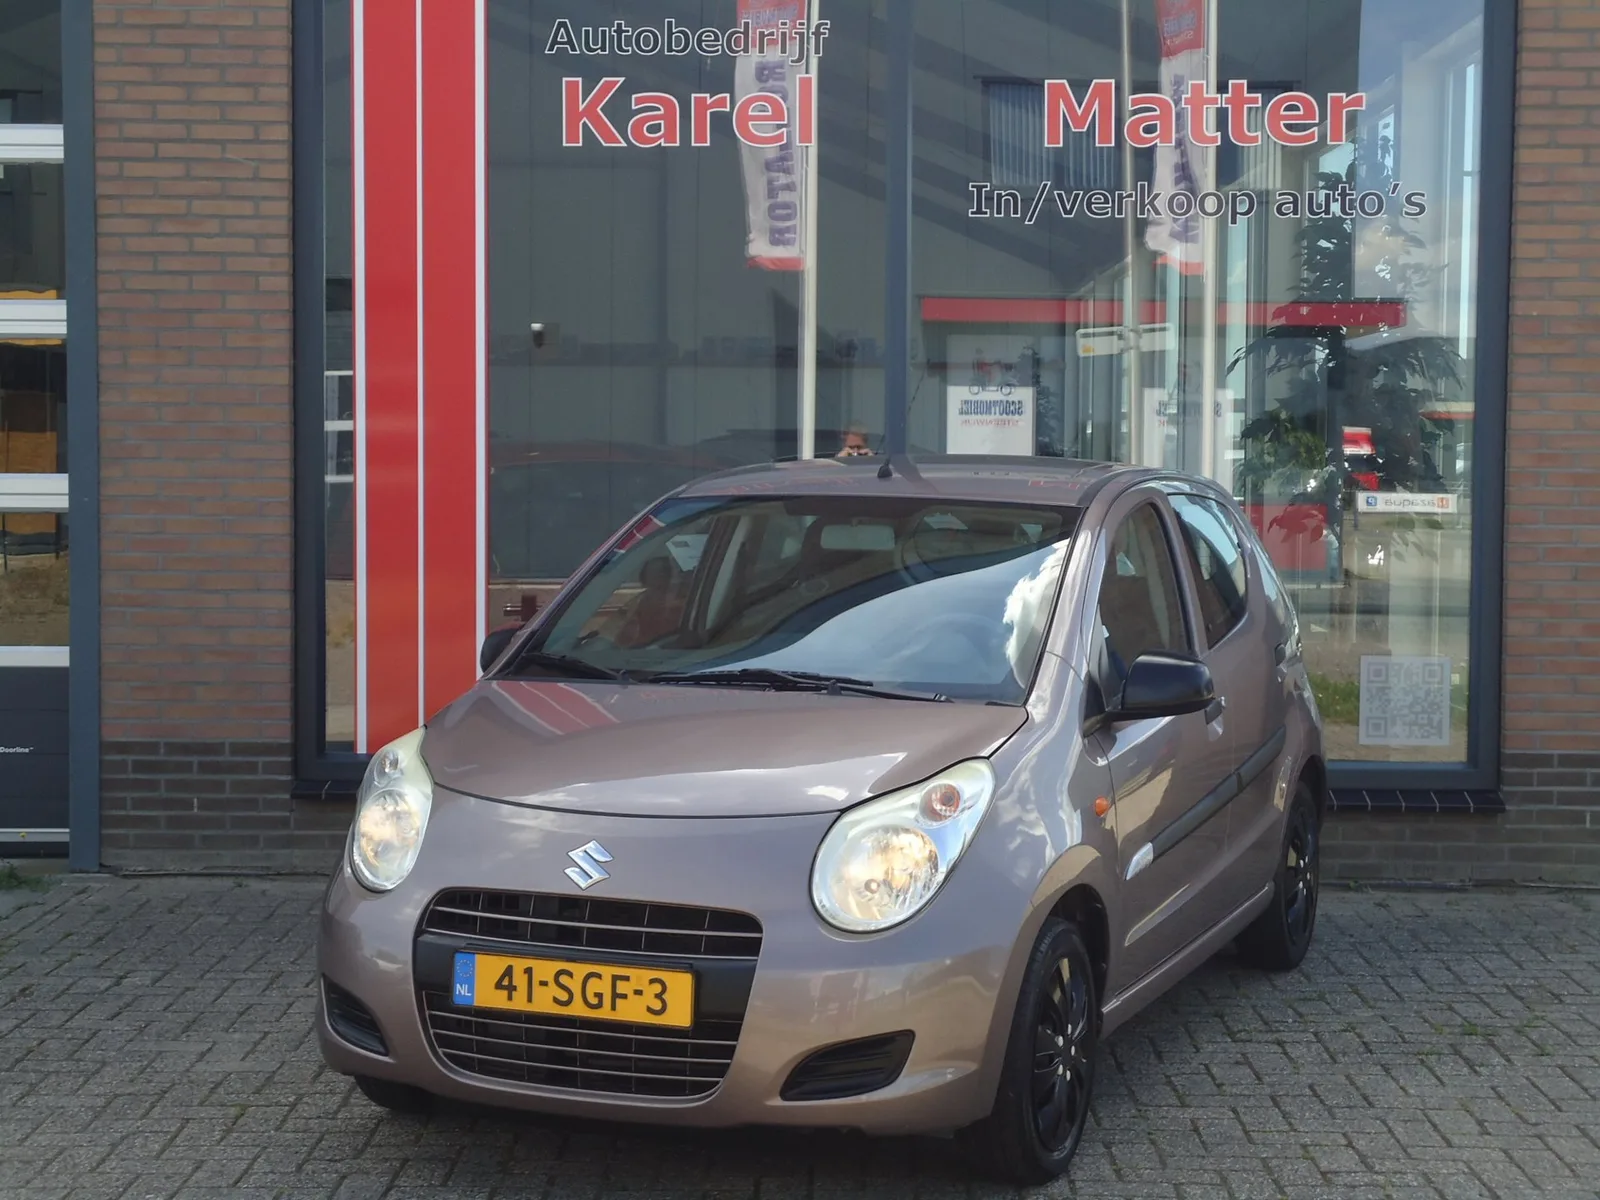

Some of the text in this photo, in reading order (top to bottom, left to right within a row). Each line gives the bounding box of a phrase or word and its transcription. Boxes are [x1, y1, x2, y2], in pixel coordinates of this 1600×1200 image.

[545, 18, 830, 65] Autobedrijf
[562, 74, 1366, 148] Karel Matter
[968, 181, 1427, 226] In/verkoop auto's
[455, 983, 472, 997] NL
[494, 964, 668, 1016] 41-SGF-3
